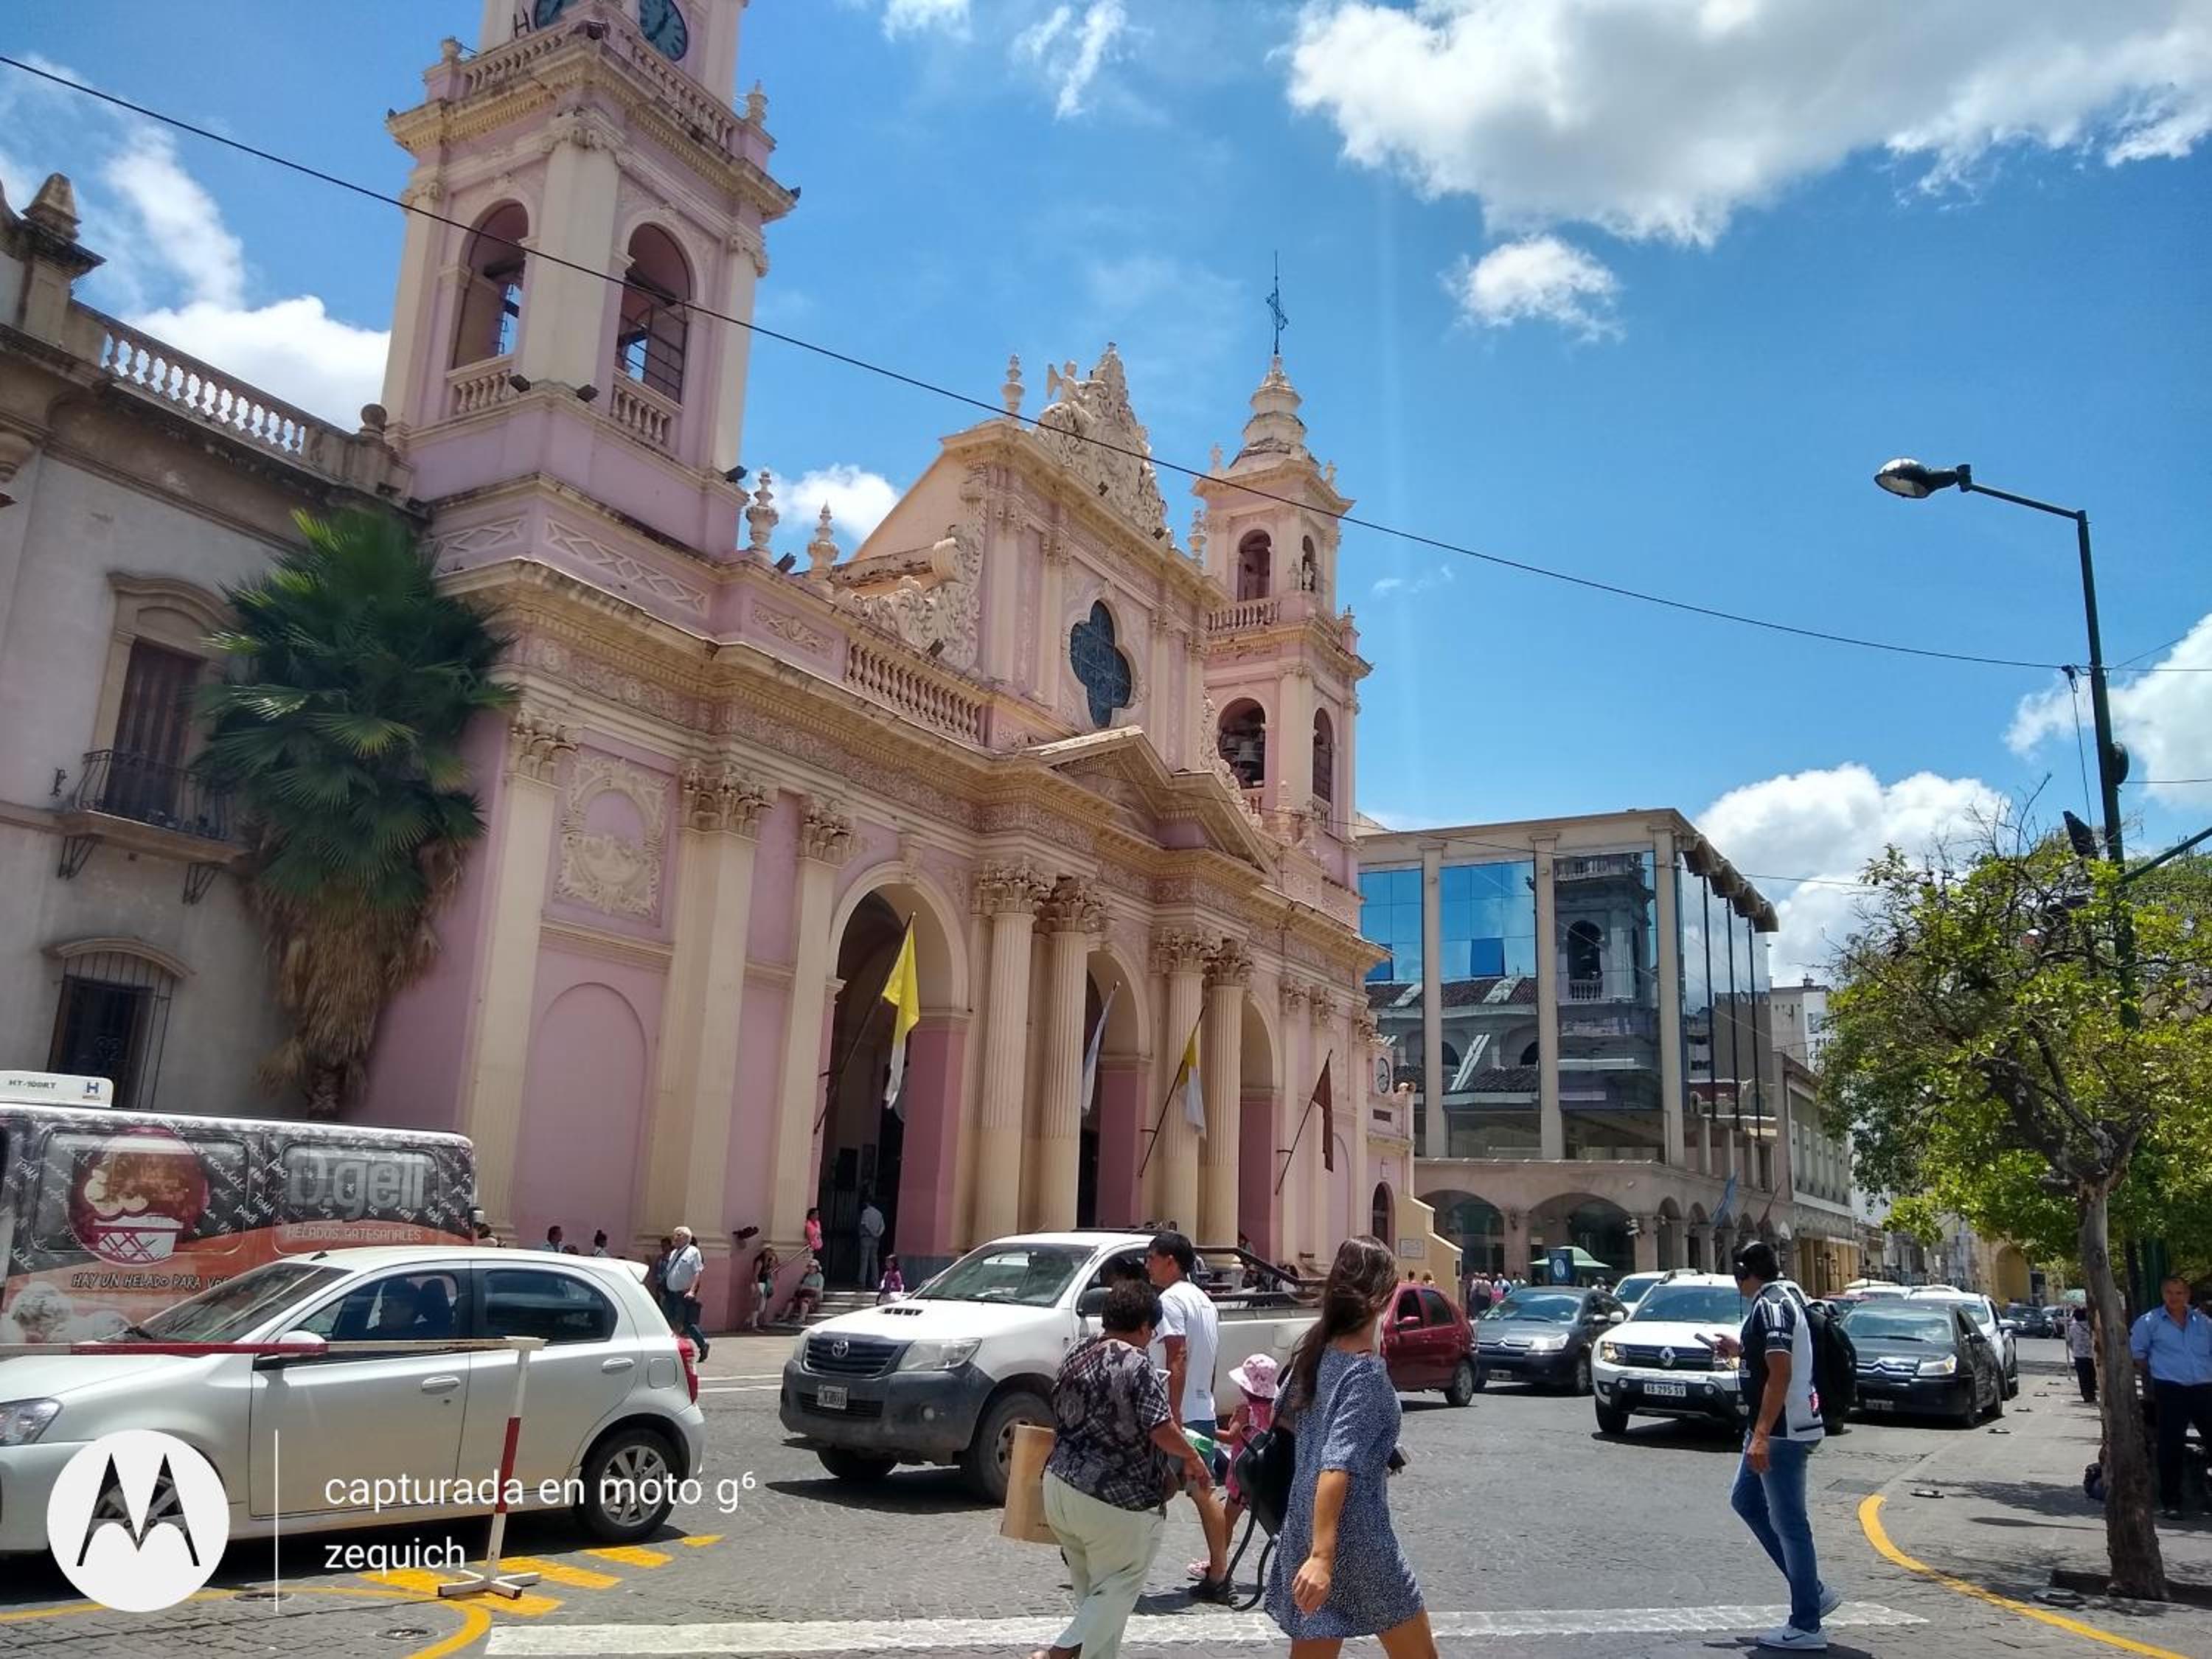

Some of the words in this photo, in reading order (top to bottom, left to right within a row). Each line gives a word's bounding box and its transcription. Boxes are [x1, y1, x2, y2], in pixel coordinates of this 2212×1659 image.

[72, 1273, 100, 1289] HAY
[100, 1273, 120, 1289] UN
[123, 1274, 170, 1289] HELADO
[171, 1276, 201, 1290] PARA
